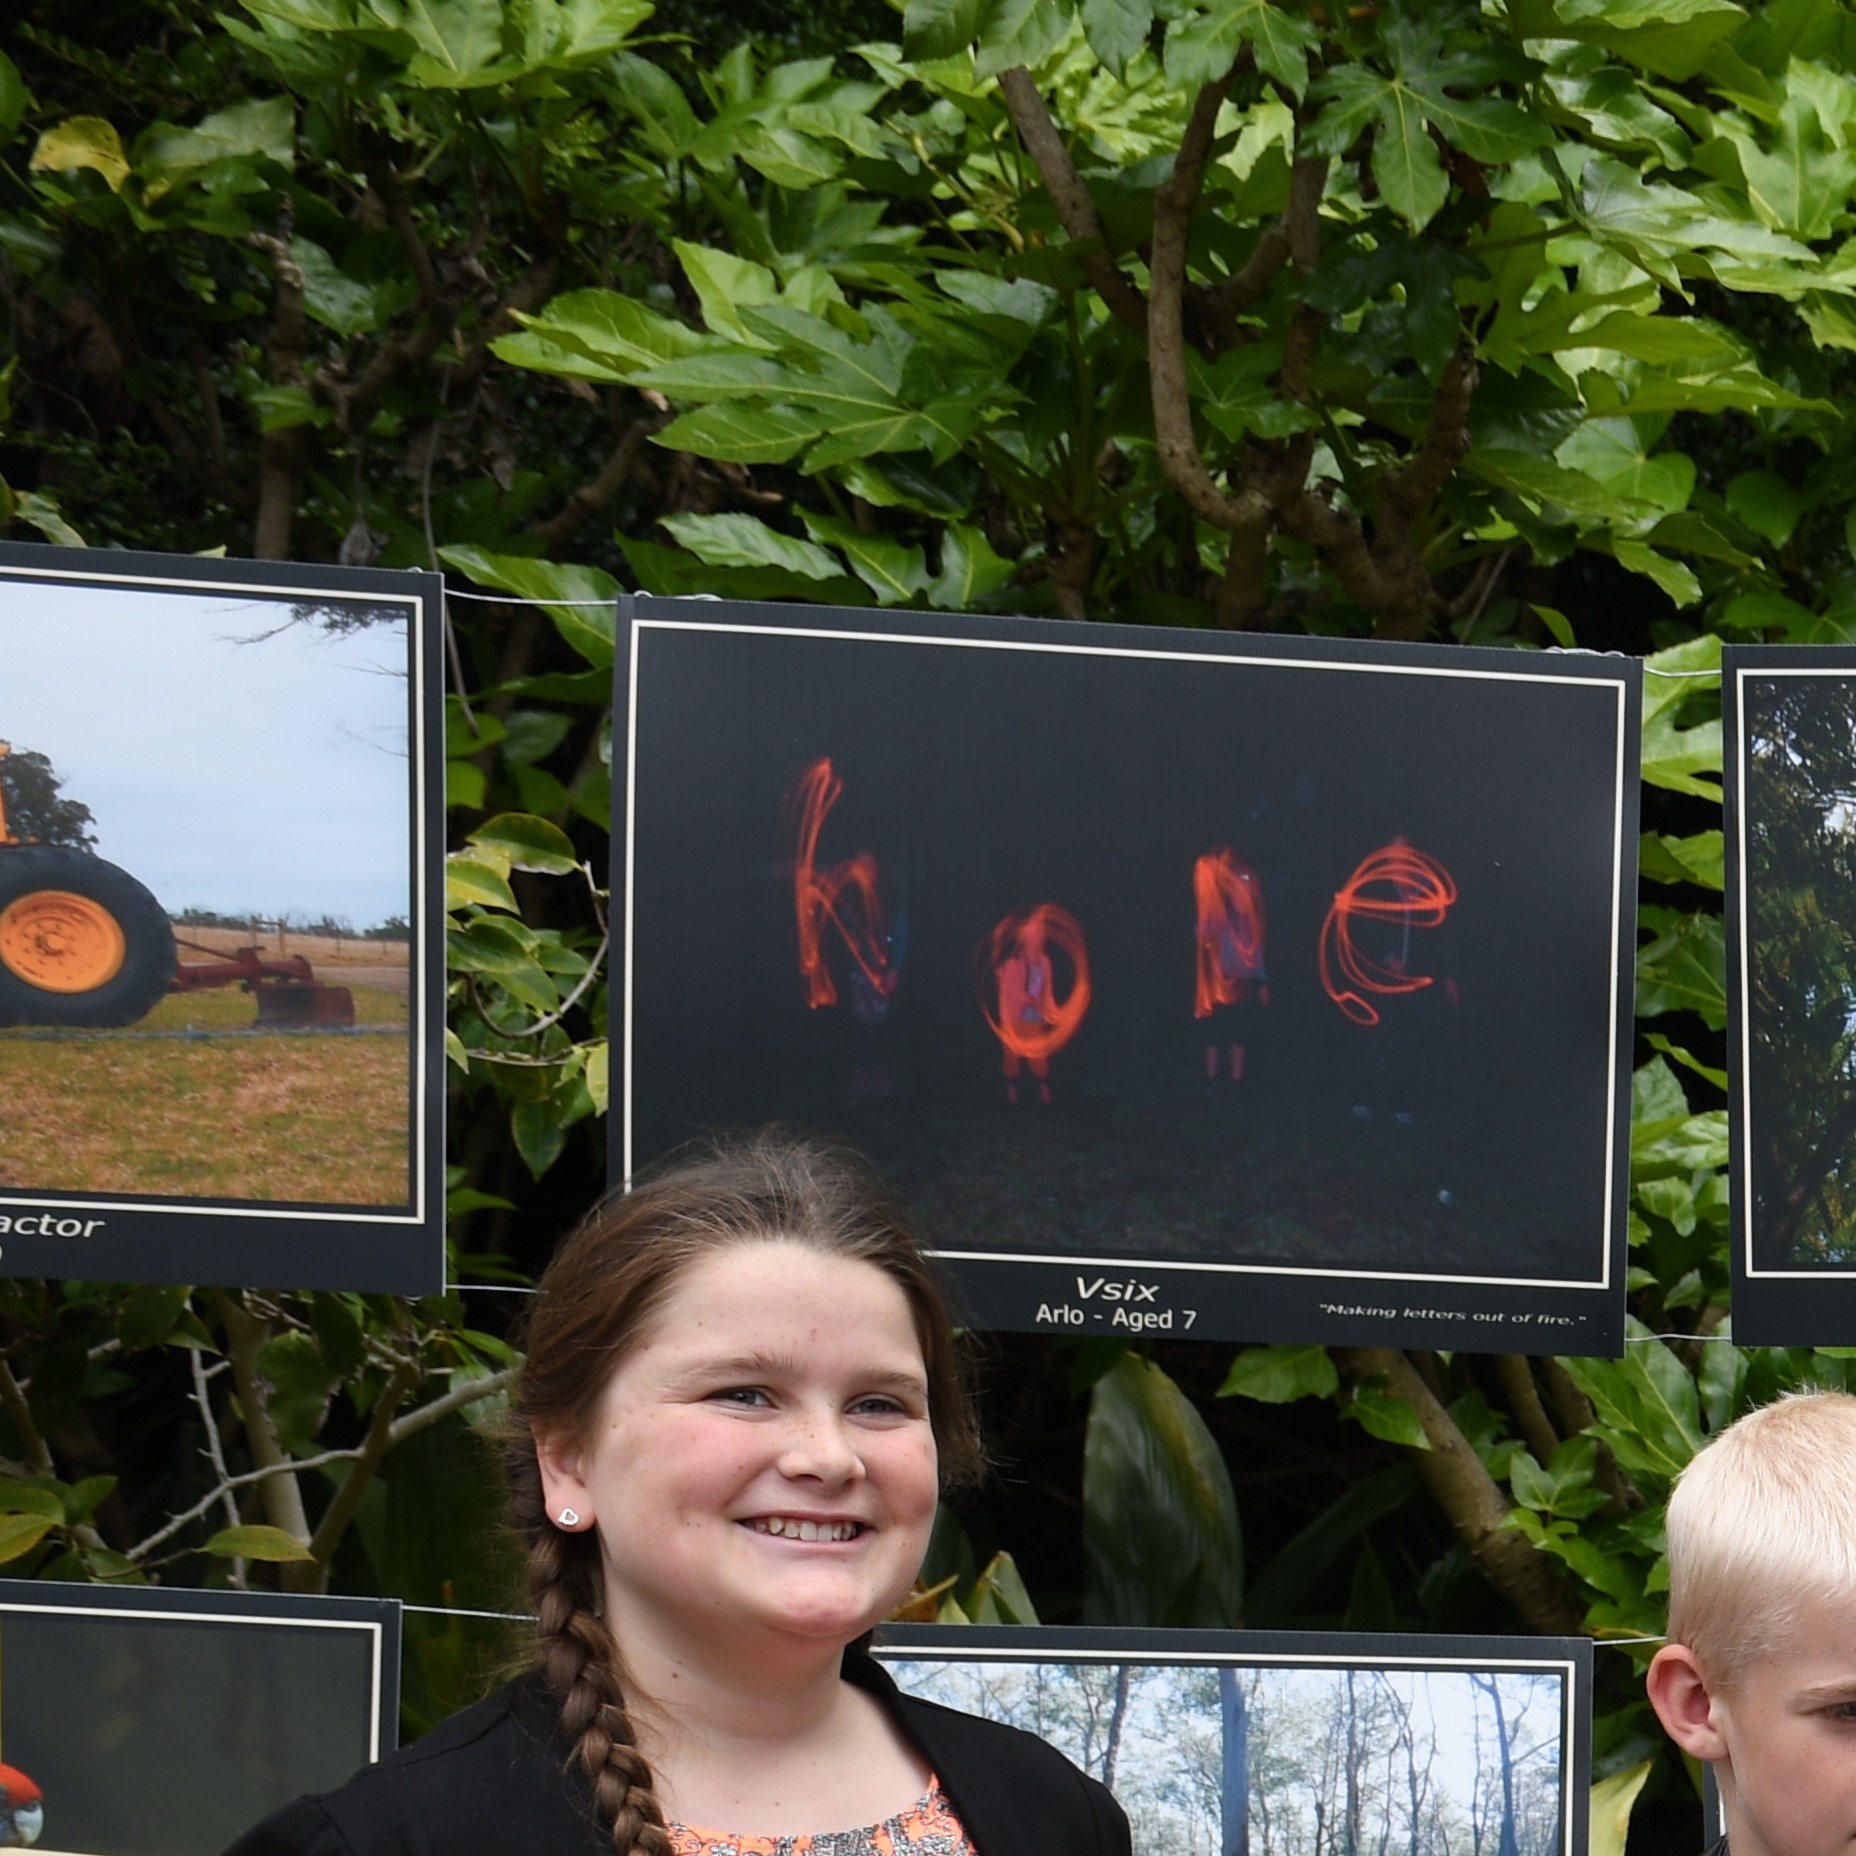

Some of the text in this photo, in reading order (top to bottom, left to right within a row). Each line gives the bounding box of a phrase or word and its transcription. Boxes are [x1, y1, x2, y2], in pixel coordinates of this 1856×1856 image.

[1076, 1276, 1160, 1303] Vsix
[1035, 1303, 1085, 1325] Arlo
[1112, 1307, 1173, 1333] Aged
[1182, 1310, 1198, 1330] 7
[1403, 1307, 1467, 1321] letters
[1472, 1312, 1504, 1323] out
[1511, 1313, 1532, 1324] of
